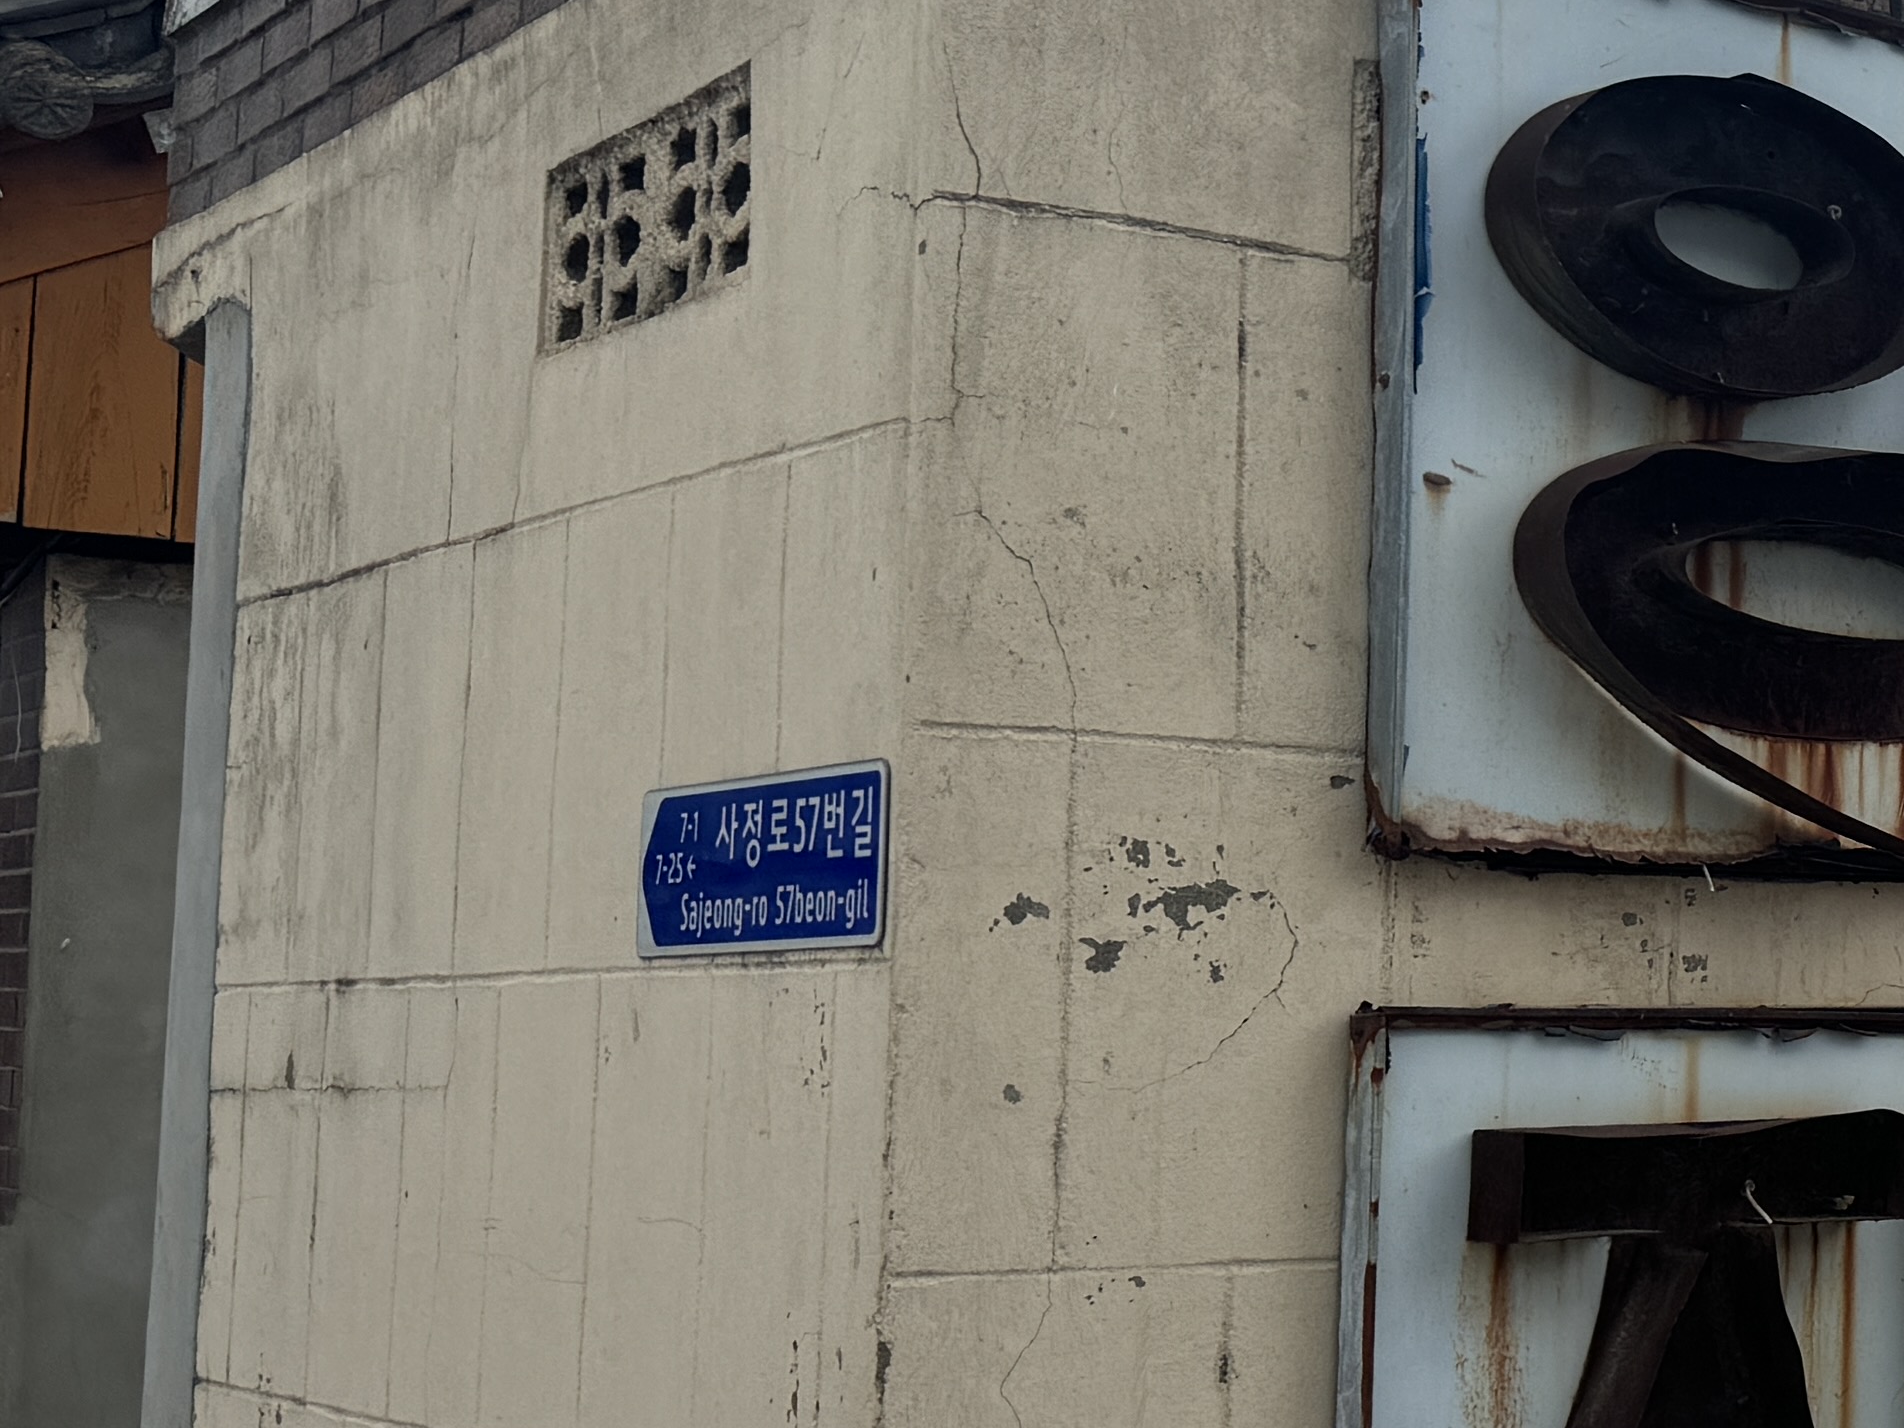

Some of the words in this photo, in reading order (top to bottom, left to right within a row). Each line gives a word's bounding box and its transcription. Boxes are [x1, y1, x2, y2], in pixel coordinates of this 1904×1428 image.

[680, 811, 699, 843] 7-1
[715, 786, 874, 868] 사정로57번길
[655, 852, 684, 885] 7-25
[680, 892, 768, 938] Sajeong-ro
[774, 878, 868, 929] 57beon-gil
